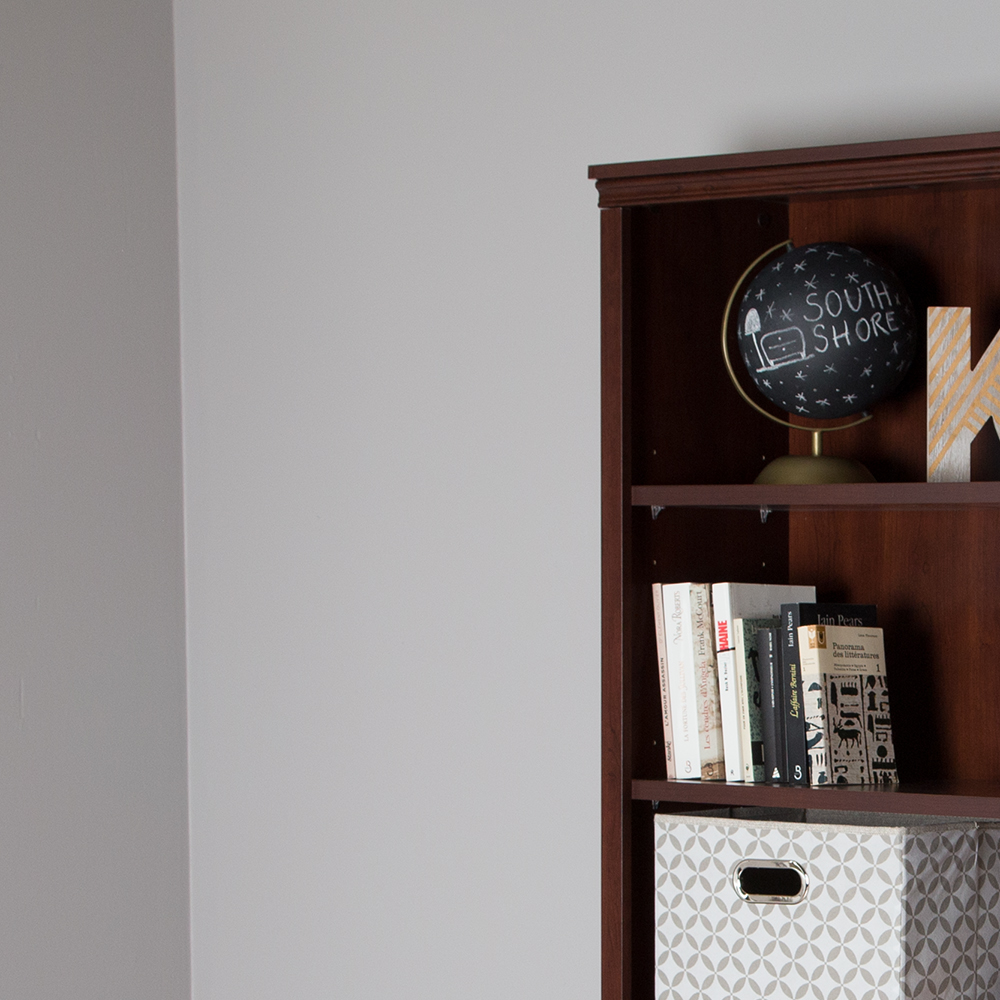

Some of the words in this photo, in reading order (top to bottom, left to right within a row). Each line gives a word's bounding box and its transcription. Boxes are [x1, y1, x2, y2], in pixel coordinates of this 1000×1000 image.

[803, 281, 891, 323] SOUTH
[813, 311, 899, 353] SHORE
[817, 614, 836, 626] Iain
[837, 614, 863, 626] Pears
[698, 632, 706, 655] Frank
[718, 620, 729, 650] HAINE
[832, 642, 865, 651] Panorama
[844, 651, 880, 660] littératures
[789, 664, 797, 688] Bernini
[790, 690, 800, 718] L'affaire
[703, 735, 711, 750] Les
